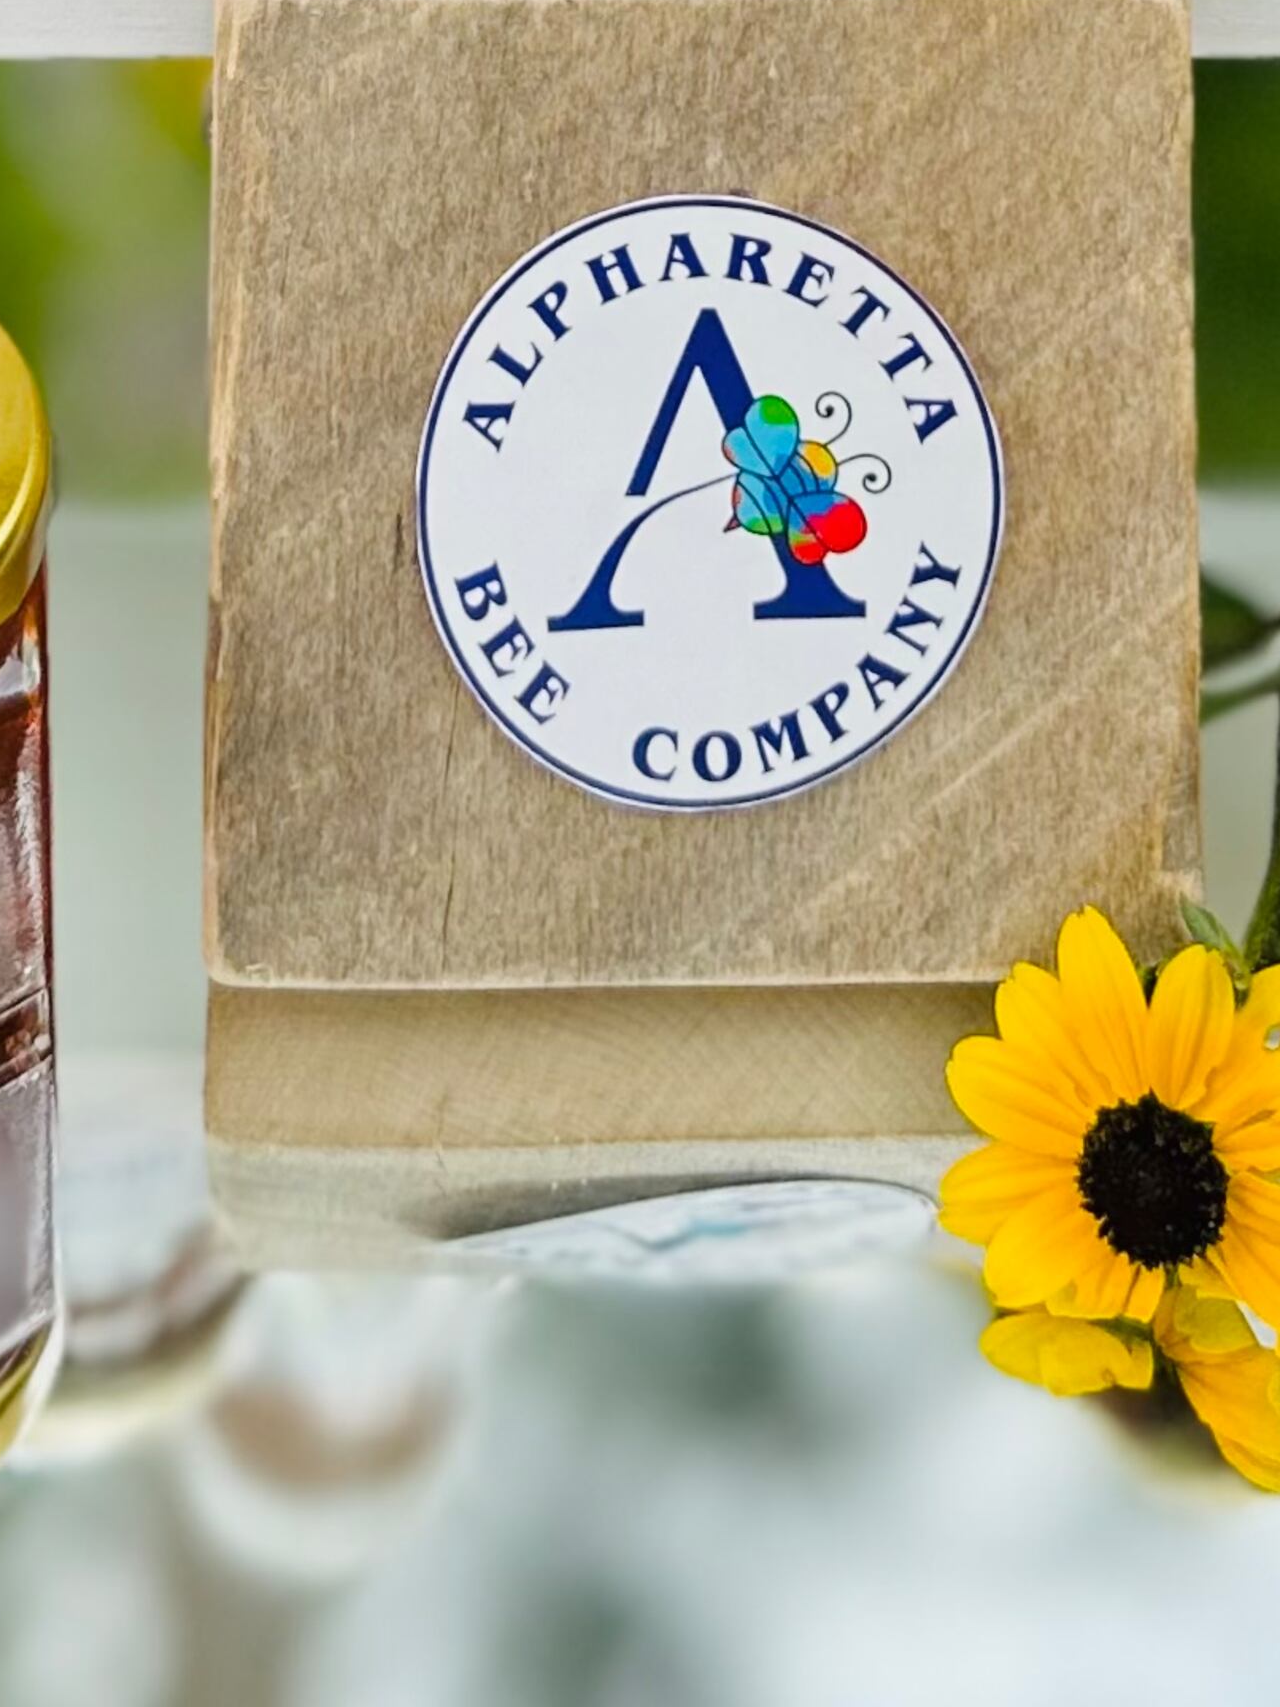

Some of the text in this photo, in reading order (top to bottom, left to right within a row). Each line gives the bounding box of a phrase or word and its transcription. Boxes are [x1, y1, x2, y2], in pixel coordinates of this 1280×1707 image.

[462, 232, 959, 452] ALPHARETTA
[454, 542, 961, 782] BEE COMPANY
